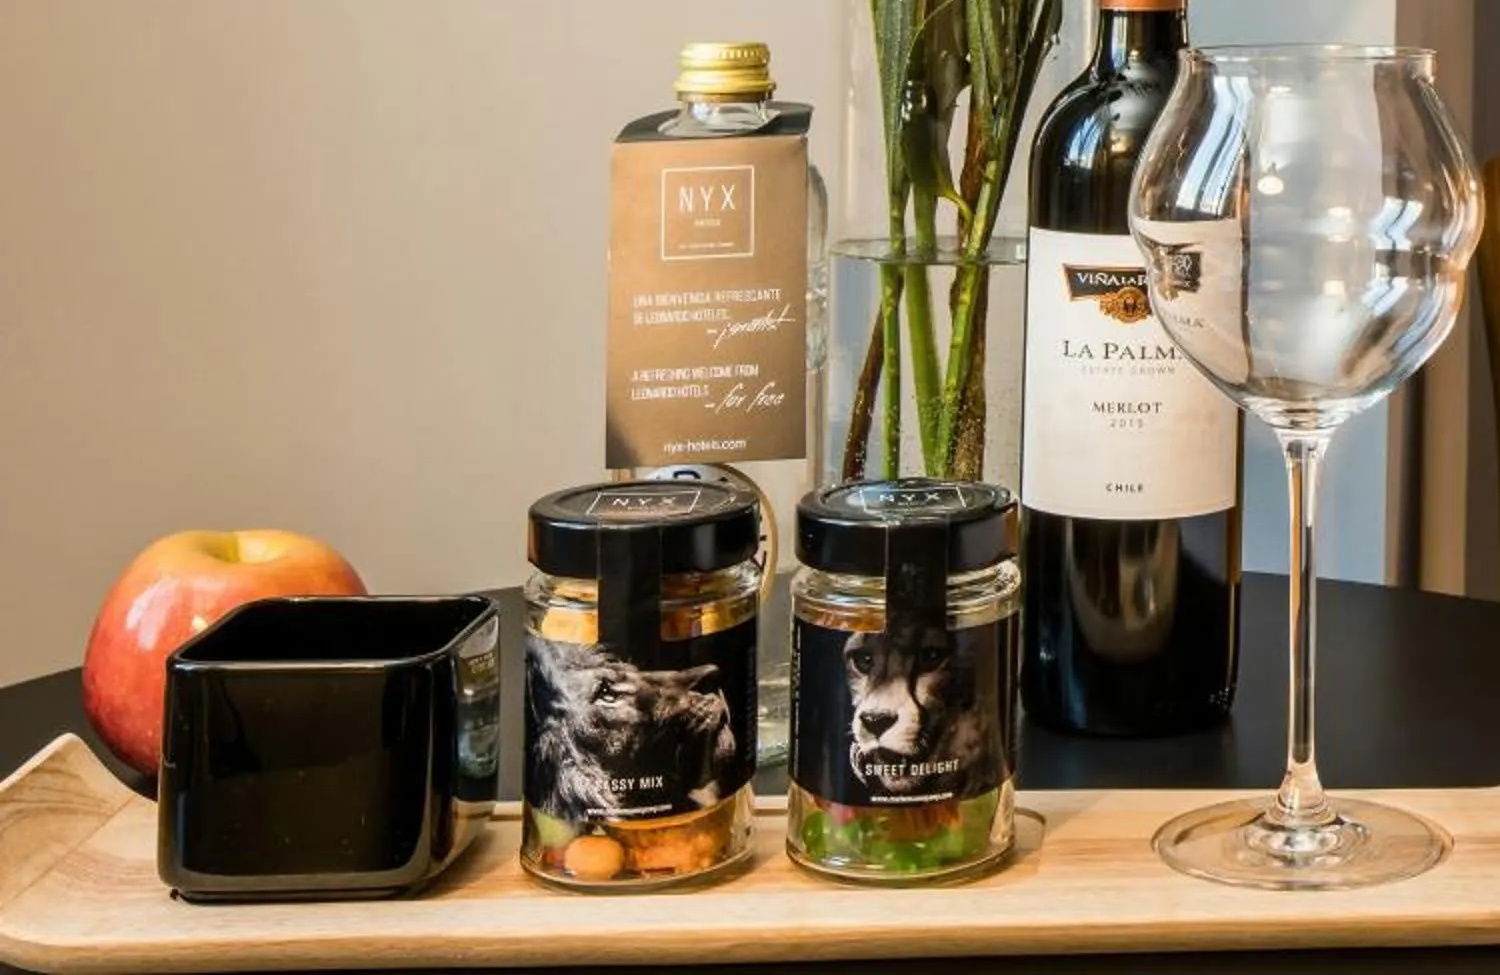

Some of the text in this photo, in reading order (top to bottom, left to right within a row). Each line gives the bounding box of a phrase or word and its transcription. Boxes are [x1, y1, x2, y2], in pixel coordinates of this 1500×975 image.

[679, 184, 735, 212] NYX
[1076, 272, 1120, 286] VIÑA
[1062, 340, 1183, 360] LA PALM
[1090, 401, 1164, 414] MERLOT
[663, 439, 747, 455] nyx-hotels.com
[1105, 482, 1144, 494] CHILE
[612, 496, 677, 506] NYX
[879, 492, 941, 503] NYX
[865, 758, 960, 776] SWEET DELIGHT
[639, 776, 663, 790] MIX
